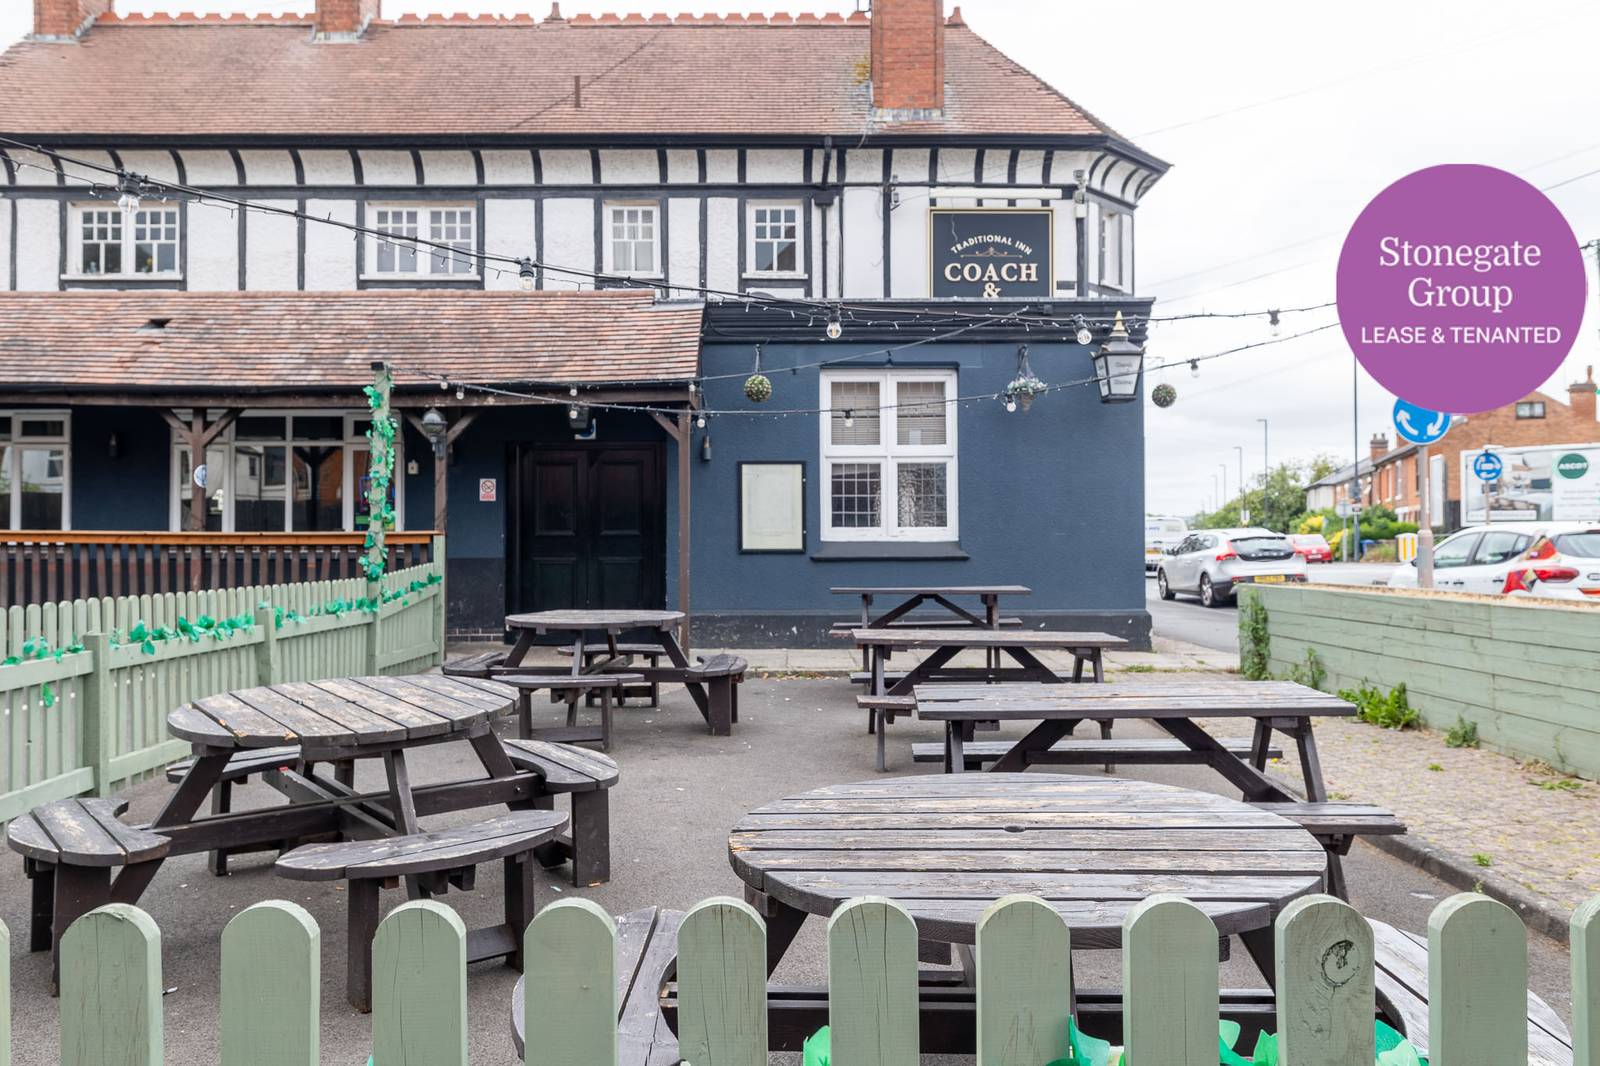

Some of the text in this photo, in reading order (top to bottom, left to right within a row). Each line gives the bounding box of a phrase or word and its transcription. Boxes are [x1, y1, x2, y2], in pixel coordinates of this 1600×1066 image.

[950, 234, 1033, 255] TRADITIONAL INN
[944, 262, 1039, 282] COACH
[982, 282, 1002, 298] &
